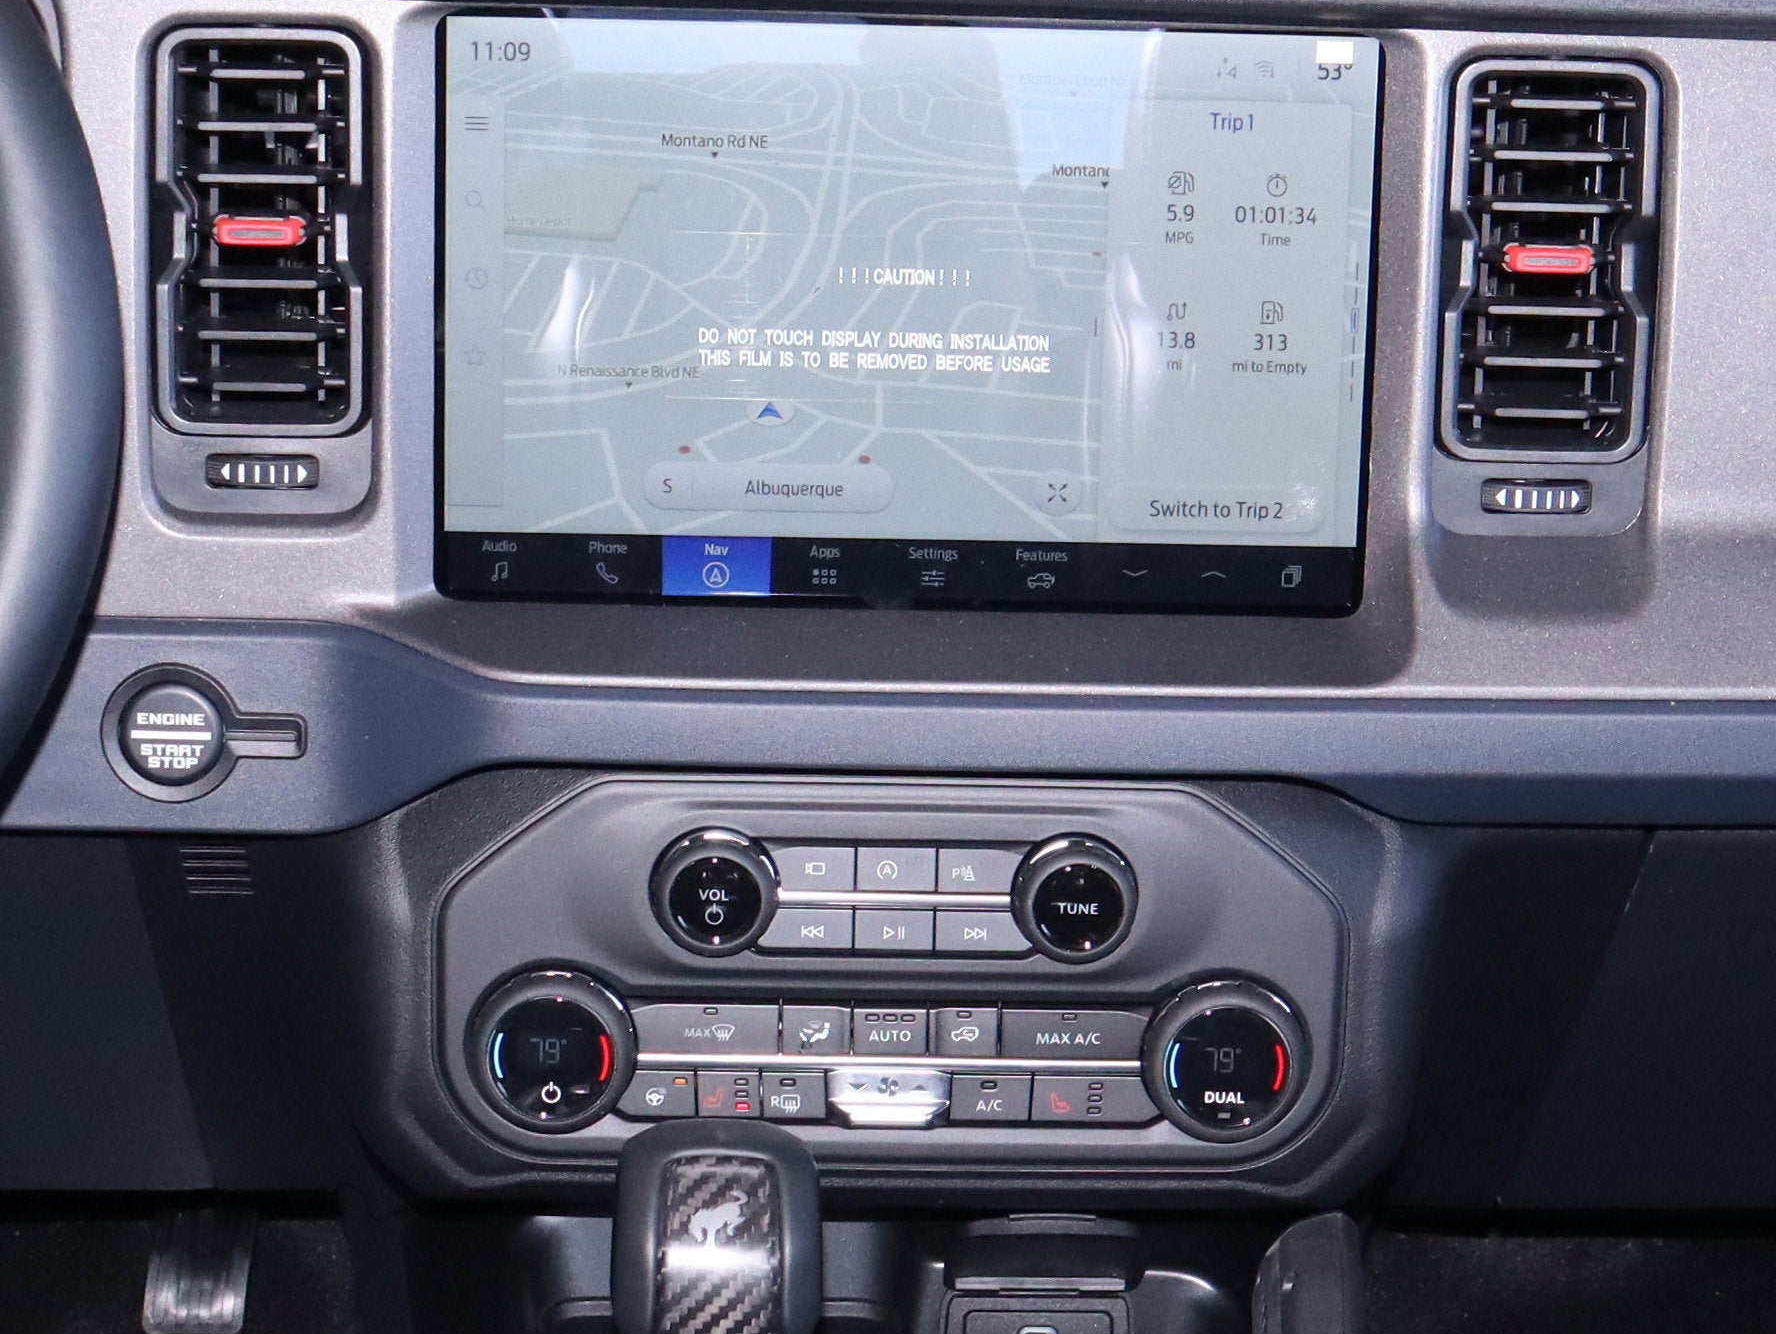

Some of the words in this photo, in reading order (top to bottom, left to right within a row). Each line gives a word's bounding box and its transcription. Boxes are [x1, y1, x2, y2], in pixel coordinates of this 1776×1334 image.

[470, 41, 531, 62] 11:09
[1210, 112, 1244, 133] Trip
[1247, 113, 1254, 130] 1
[661, 133, 723, 149] Montano
[727, 133, 746, 149] Rd
[749, 134, 769, 149] NE
[1166, 204, 1195, 223] 5.9
[1235, 205, 1317, 226] 01:01:34
[1165, 231, 1195, 245] MPG
[1260, 233, 1291, 247] Time
[698, 327, 718, 345] DO
[727, 328, 756, 346] NOT
[764, 329, 814, 347] TOUCH
[821, 329, 882, 349] DISPLAY
[888, 331, 943, 350] DURING
[949, 332, 1050, 352] INSTALLATION
[1157, 331, 1196, 349] 13.8
[1254, 334, 1288, 351] 313
[698, 348, 731, 367] THIS
[739, 349, 772, 368] FILM
[779, 350, 794, 368] IS
[801, 350, 822, 369] TO
[829, 351, 849, 369] BE
[857, 352, 928, 371] REMOVED
[936, 353, 995, 372] BEFORE
[1001, 354, 1051, 373] USAGE
[1166, 358, 1183, 371] mi
[570, 364, 648, 379] Renaissance
[651, 364, 679, 379] Blvd
[682, 366, 701, 380] NE
[1232, 361, 1250, 373] mi
[1251, 361, 1264, 373] to
[1266, 361, 1307, 376] Empty
[663, 478, 673, 495] S
[744, 478, 844, 500] Albuquerque
[1149, 500, 1208, 518] Switch
[1214, 503, 1231, 518] to
[1236, 501, 1270, 522] Trip
[1272, 502, 1283, 519] 2
[481, 539, 517, 554] Audio
[588, 540, 628, 555] Phone
[704, 543, 729, 557] Nav
[810, 544, 841, 562] Apps
[908, 546, 959, 564] Settings
[1015, 548, 1069, 563] Features
[136, 712, 205, 726] ENGINE
[140, 743, 204, 757] START
[147, 756, 199, 769] STOP
[698, 888, 729, 902] VOL
[1057, 902, 1099, 916] TUNE
[683, 1028, 711, 1038] MAX
[869, 1030, 912, 1043] AUTO
[1035, 1032, 1071, 1045] MAX
[1073, 1032, 1101, 1046] A/C
[1204, 1090, 1245, 1105] DUAL
[976, 1099, 1003, 1113] A/C
